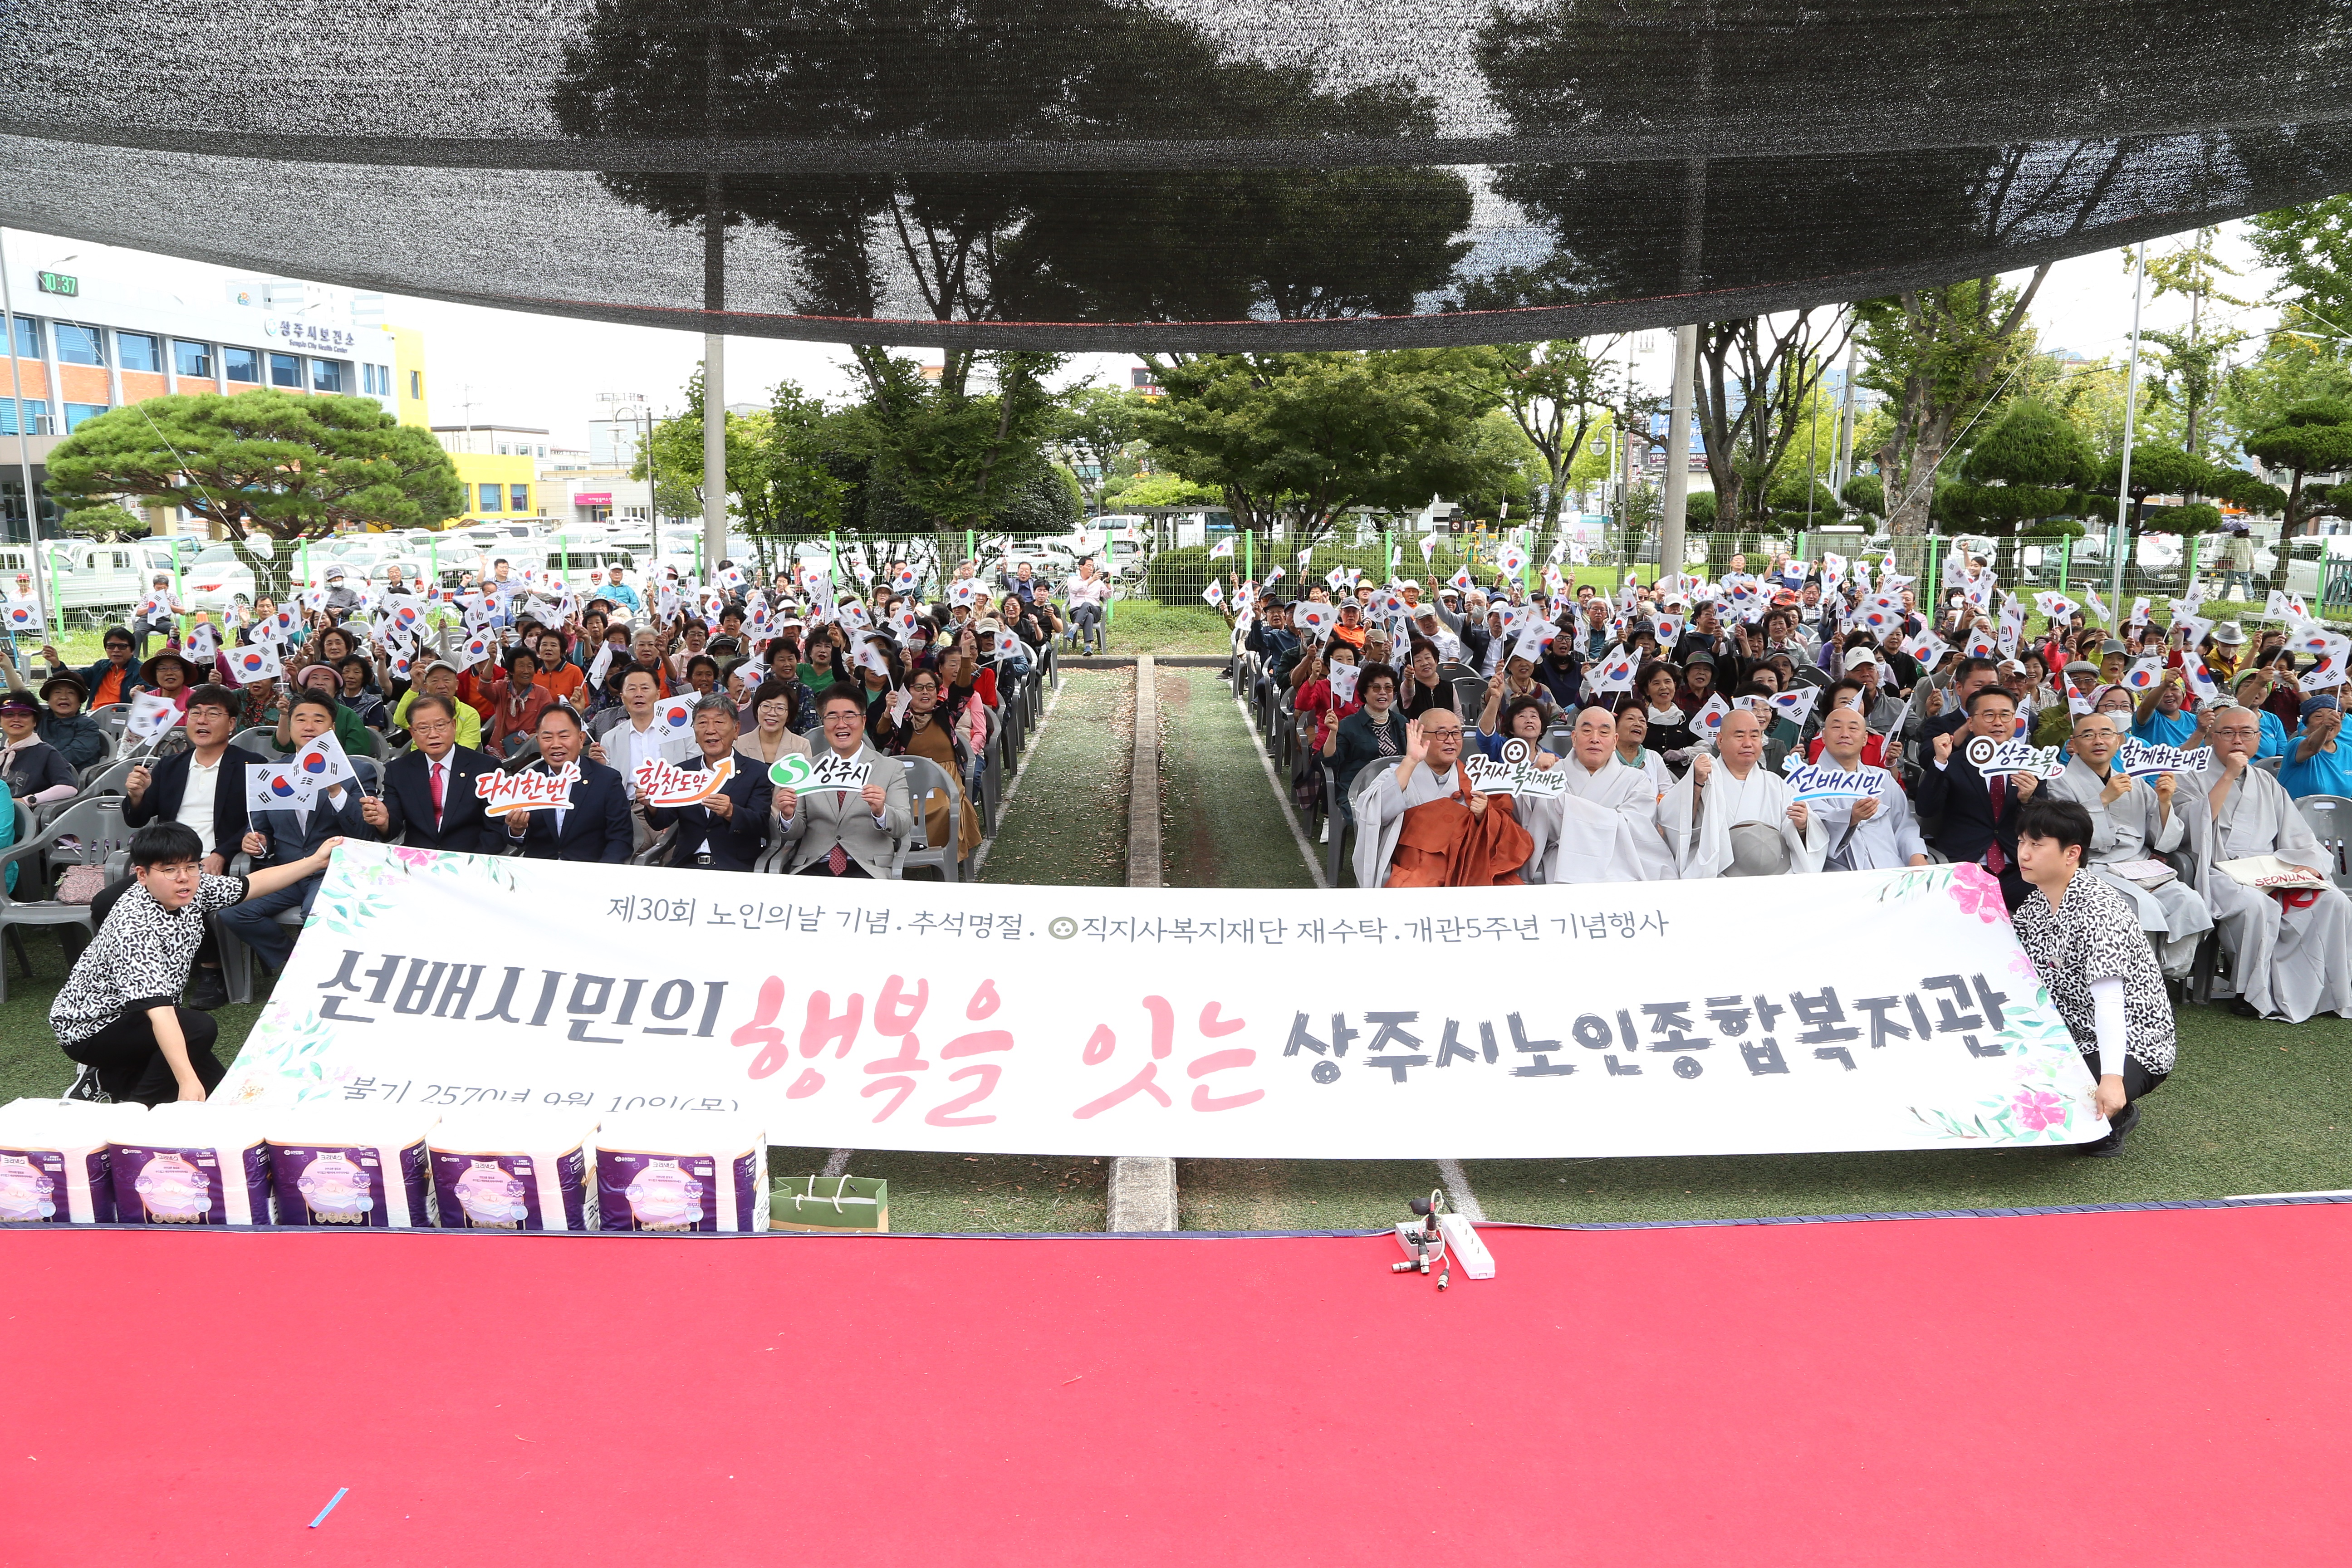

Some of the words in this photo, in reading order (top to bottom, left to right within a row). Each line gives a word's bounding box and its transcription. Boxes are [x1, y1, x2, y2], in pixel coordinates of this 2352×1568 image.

[43, 273, 76, 294] 10:37
[280, 320, 355, 346] 상주시보건소
[813, 756, 870, 786] 상주시
[1996, 743, 2057, 777] 상주노복
[1467, 756, 1511, 786] 직지사
[1511, 762, 1565, 795] 복지재단
[1786, 765, 1883, 795] 선배시민
[2255, 874, 2322, 887] SEONUN
[607, 895, 696, 926] 제30회
[706, 902, 826, 931] 노인의날
[1082, 916, 1288, 944] 직지사복지재단
[1550, 910, 1669, 939] 기념행사
[317, 949, 729, 1044] 선배시민의
[730, 974, 1014, 1127] 행복을
[1073, 995, 1265, 1119] 잇는
[1283, 972, 2011, 1085] 상주시노인종합복지관
[343, 1077, 412, 1104] 불기
